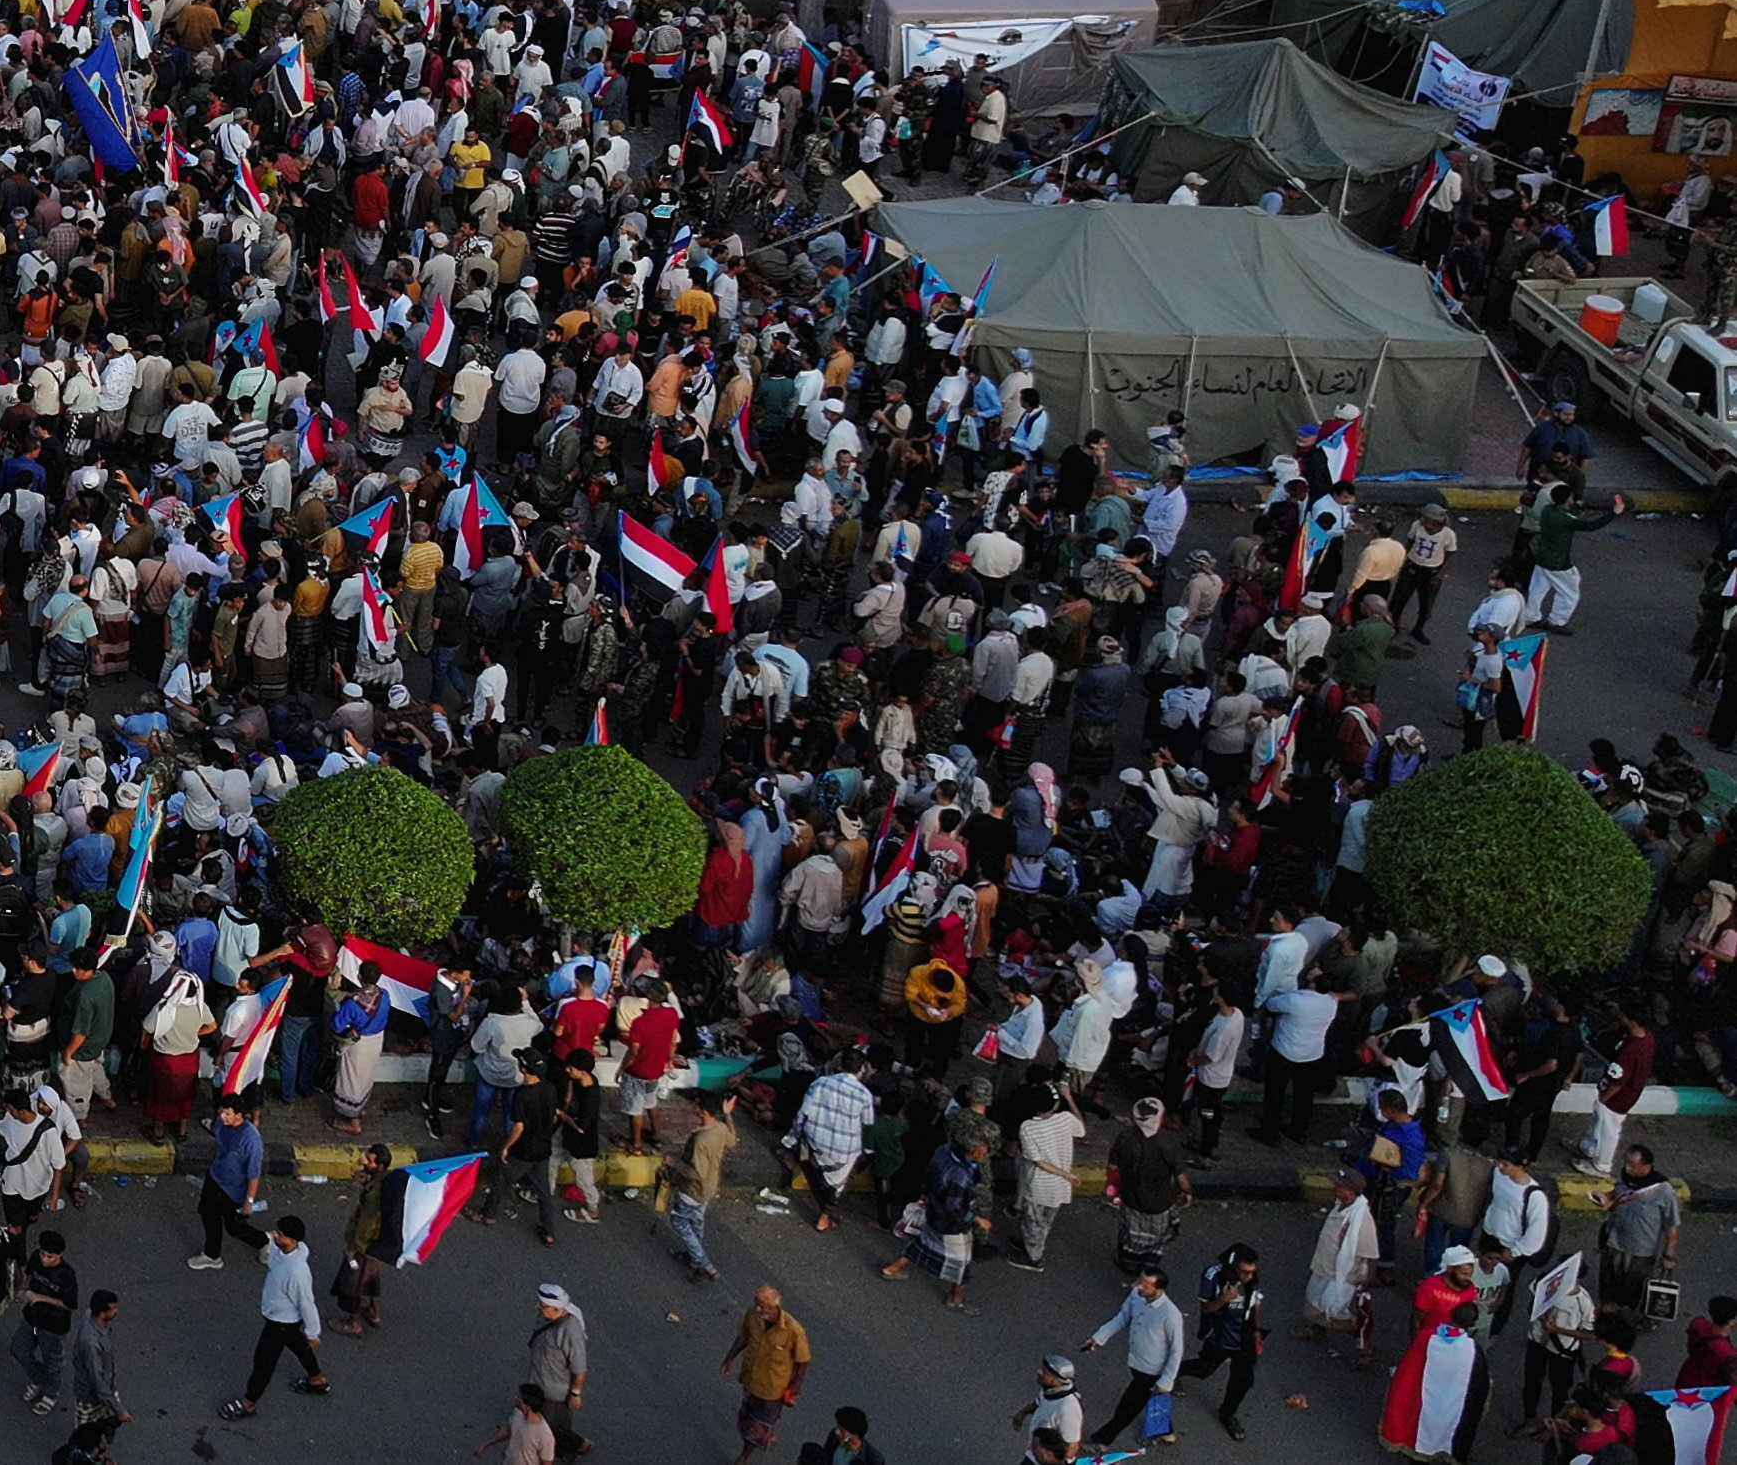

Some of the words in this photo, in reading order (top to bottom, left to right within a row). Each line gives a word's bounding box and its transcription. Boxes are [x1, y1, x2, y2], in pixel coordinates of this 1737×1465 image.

[1104, 359, 1184, 402] الجنوب
[1253, 364, 1300, 405] العام
[1301, 366, 1368, 396] الاتحاد
[1415, 538, 1438, 559] H
